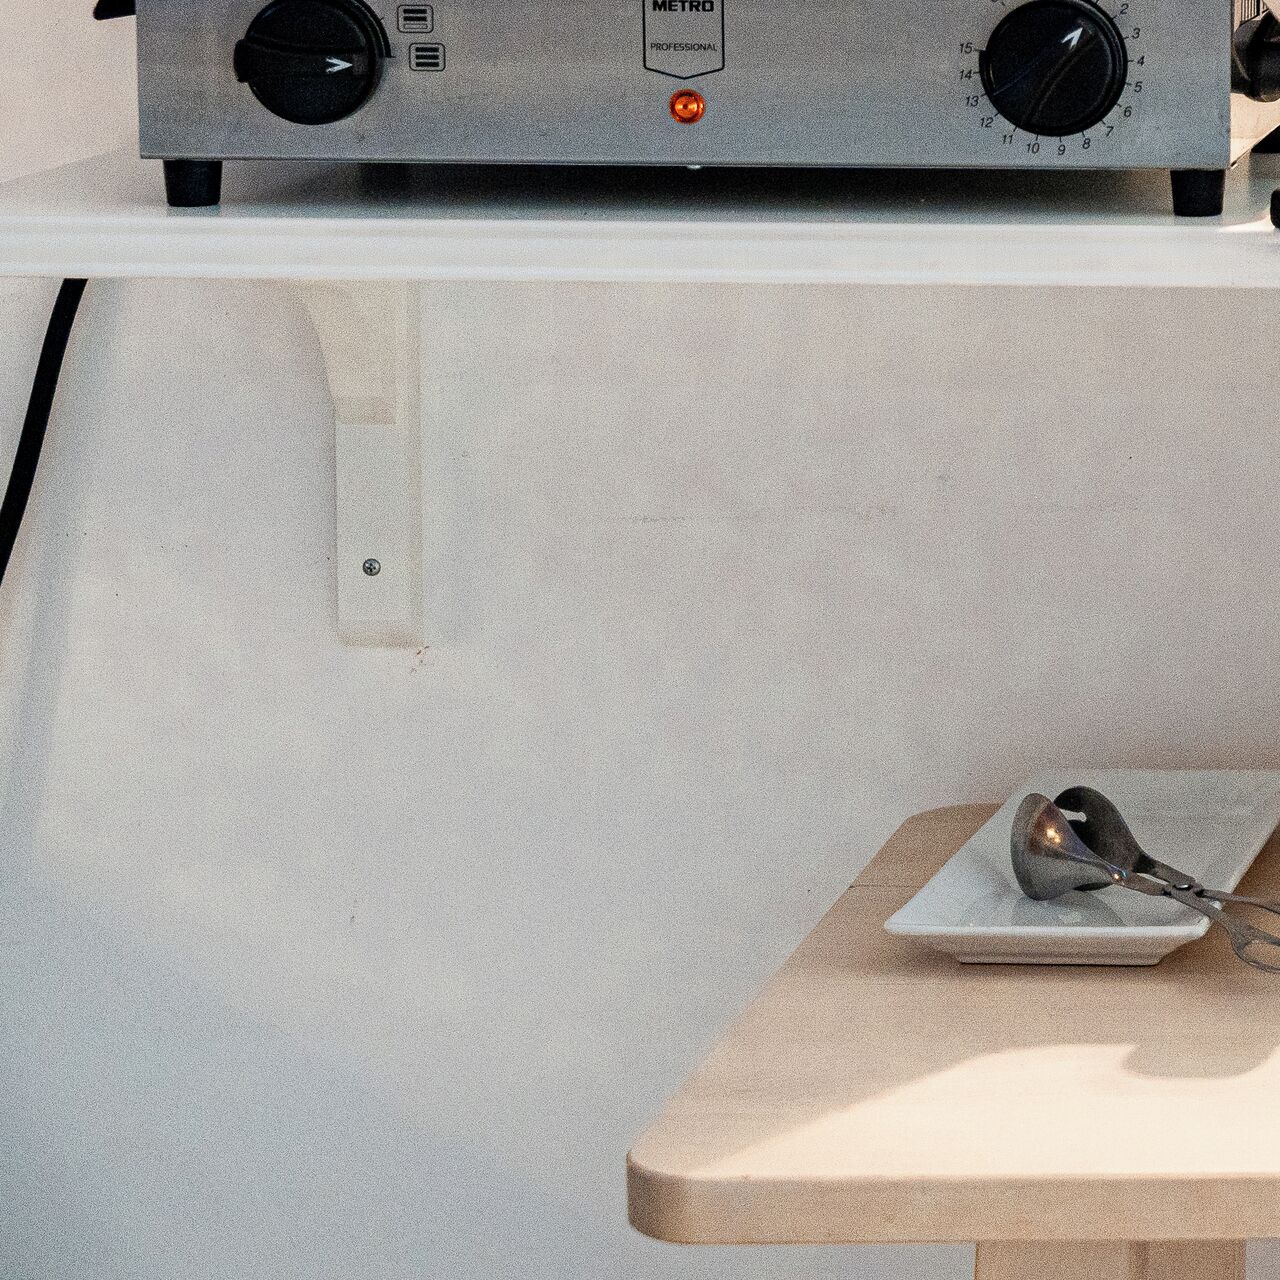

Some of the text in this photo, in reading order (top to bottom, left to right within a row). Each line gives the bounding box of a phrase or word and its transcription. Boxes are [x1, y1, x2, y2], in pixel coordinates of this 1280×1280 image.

[652, 0, 714, 12] METRO
[1119, 3, 1129, 15] 2
[1131, 27, 1141, 39] 3
[650, 43, 717, 52] PROFESSIONAL
[959, 42, 973, 55] 15
[1136, 55, 1145, 66] 4
[959, 70, 972, 80] 14
[1134, 81, 1143, 93] 5
[966, 96, 980, 107] 13
[1123, 106, 1133, 118] 6
[980, 117, 994, 128] 12
[1106, 126, 1114, 137] 7
[1002, 134, 1013, 145] 11
[1082, 138, 1091, 150] 8
[1027, 142, 1040, 154] 10
[1057, 144, 1066, 155] 9
